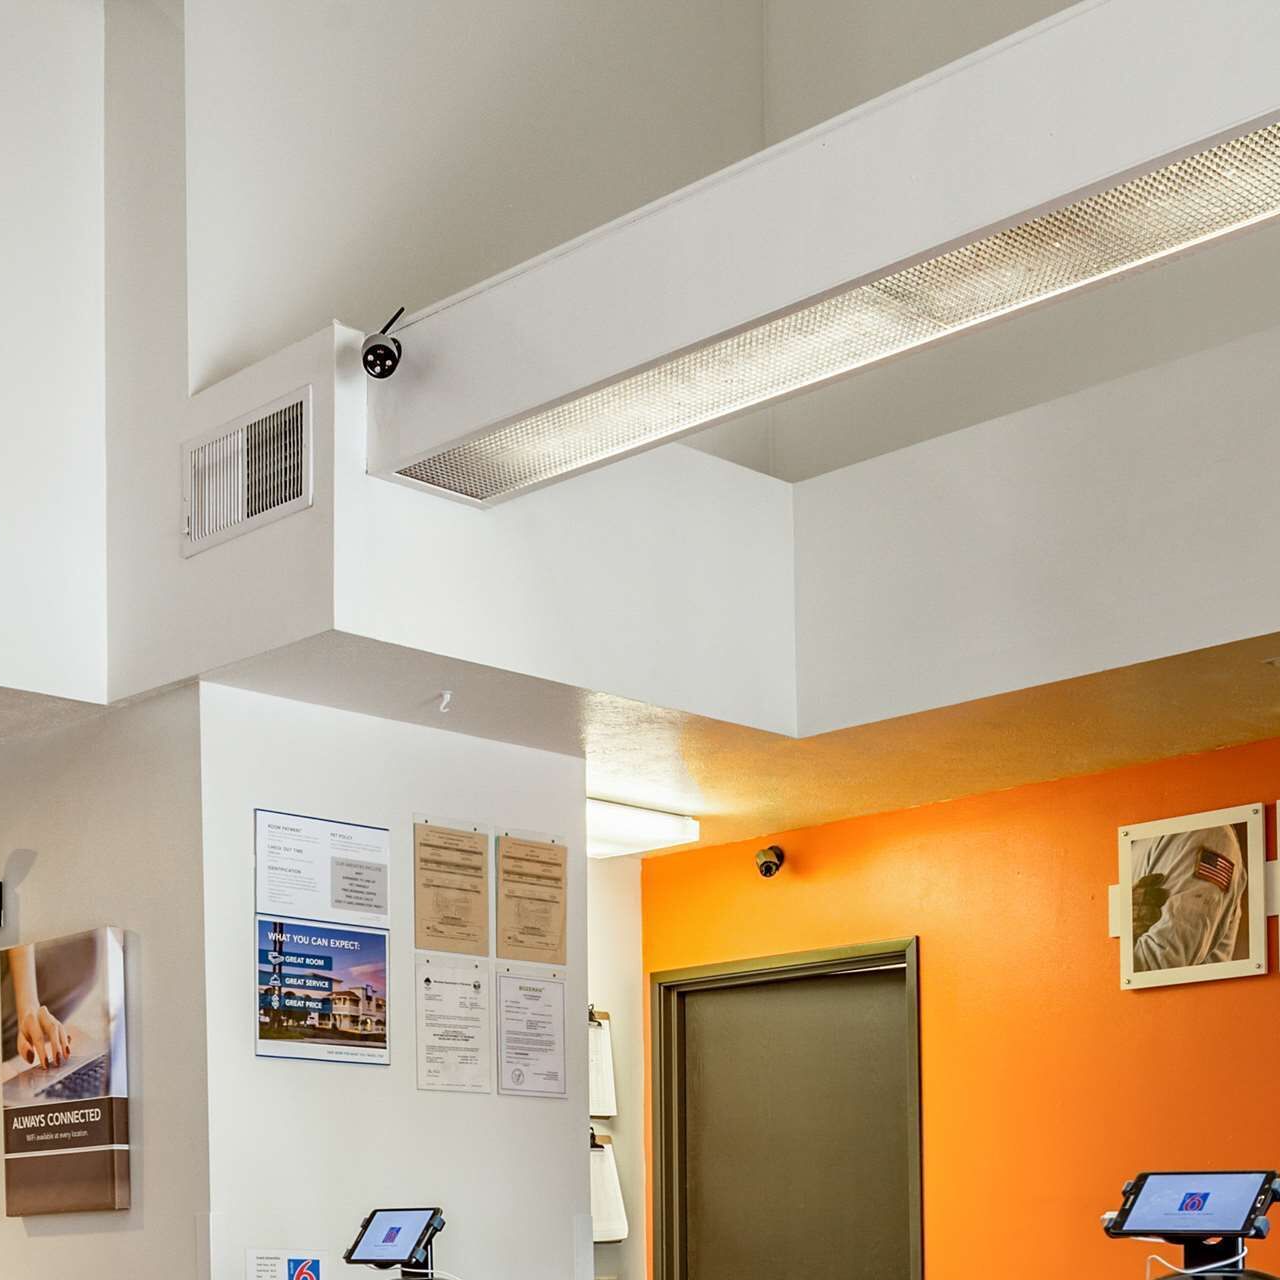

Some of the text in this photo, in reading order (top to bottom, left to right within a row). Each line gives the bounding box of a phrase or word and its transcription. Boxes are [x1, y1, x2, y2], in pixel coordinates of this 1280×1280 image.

[268, 931, 361, 951] WHAT YOU CAN EXPECT:
[285, 955, 325, 967] GREAT ROOM
[285, 977, 329, 988] GREAT SERVICE
[285, 999, 322, 1009] GREAT PRICE
[12, 1108, 101, 1129] ALWAYS CONNECTED
